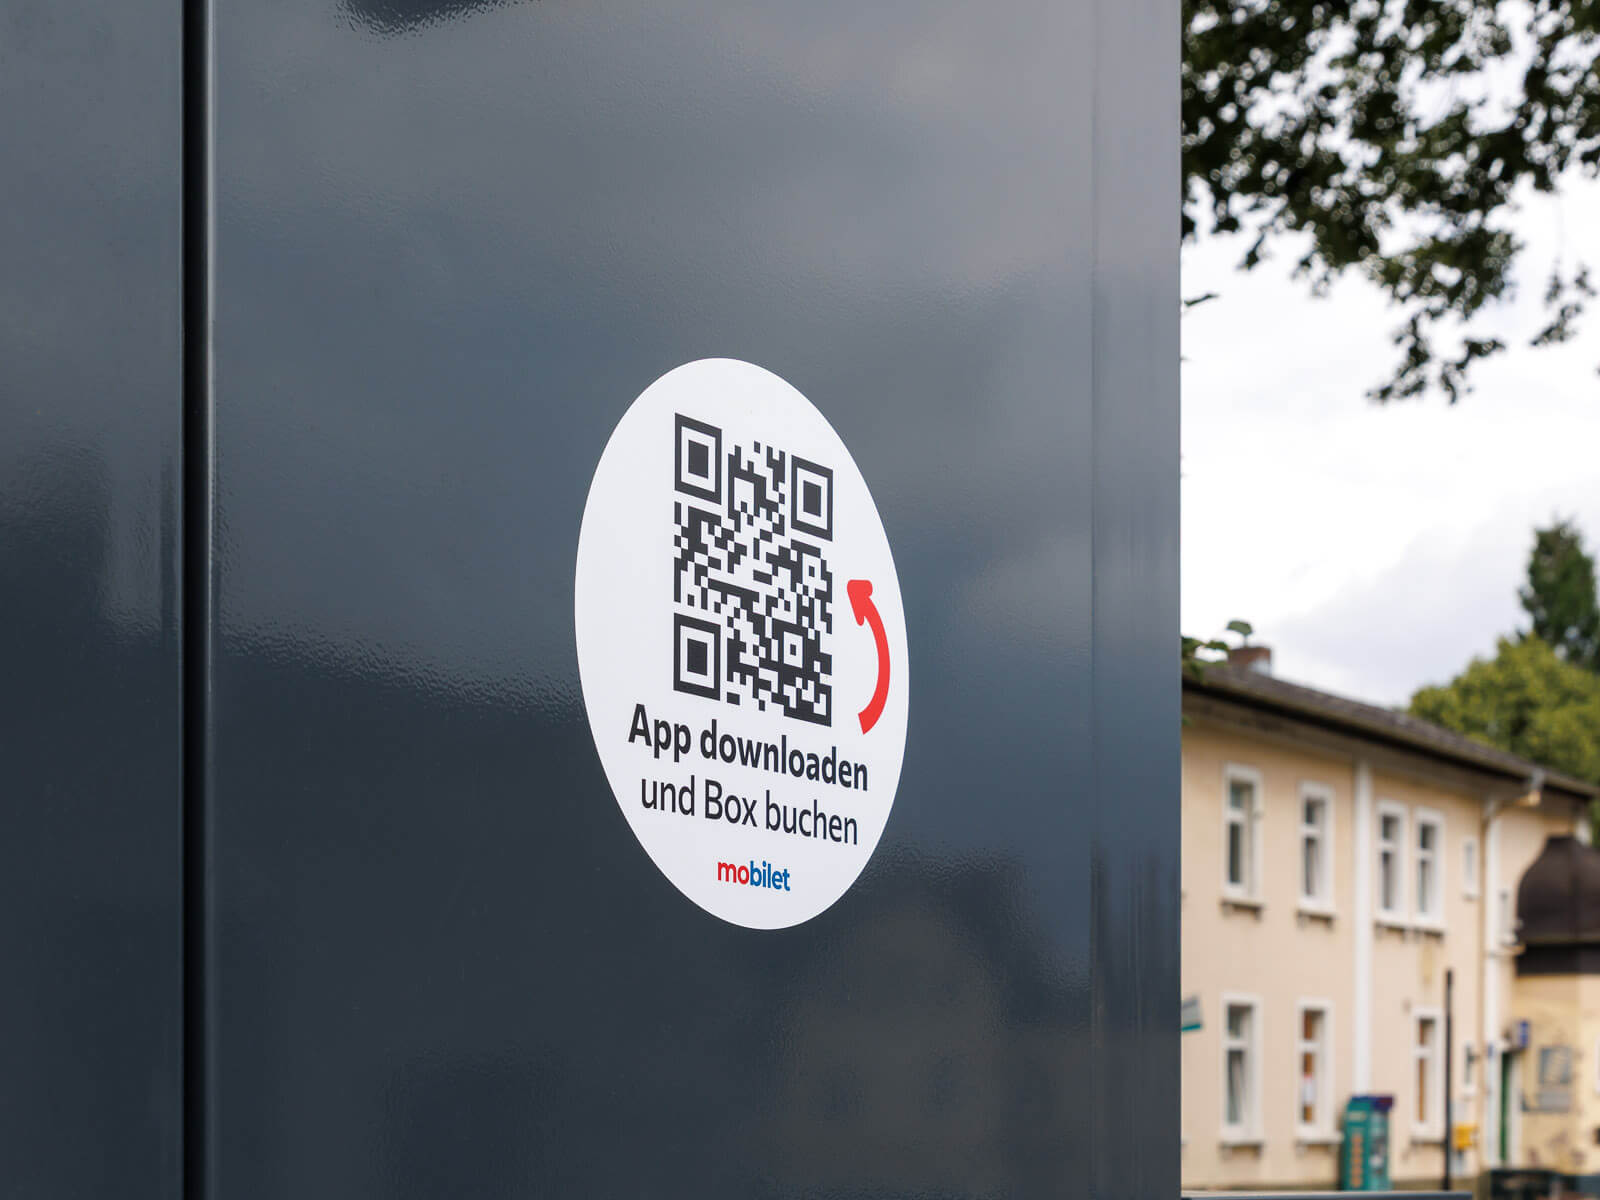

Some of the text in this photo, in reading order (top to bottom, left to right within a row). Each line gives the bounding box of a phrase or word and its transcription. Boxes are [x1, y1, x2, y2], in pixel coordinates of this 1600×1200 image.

[627, 703, 868, 792] App downloaden
[641, 774, 858, 846] und Box buchen
[717, 860, 791, 891] mobilet
